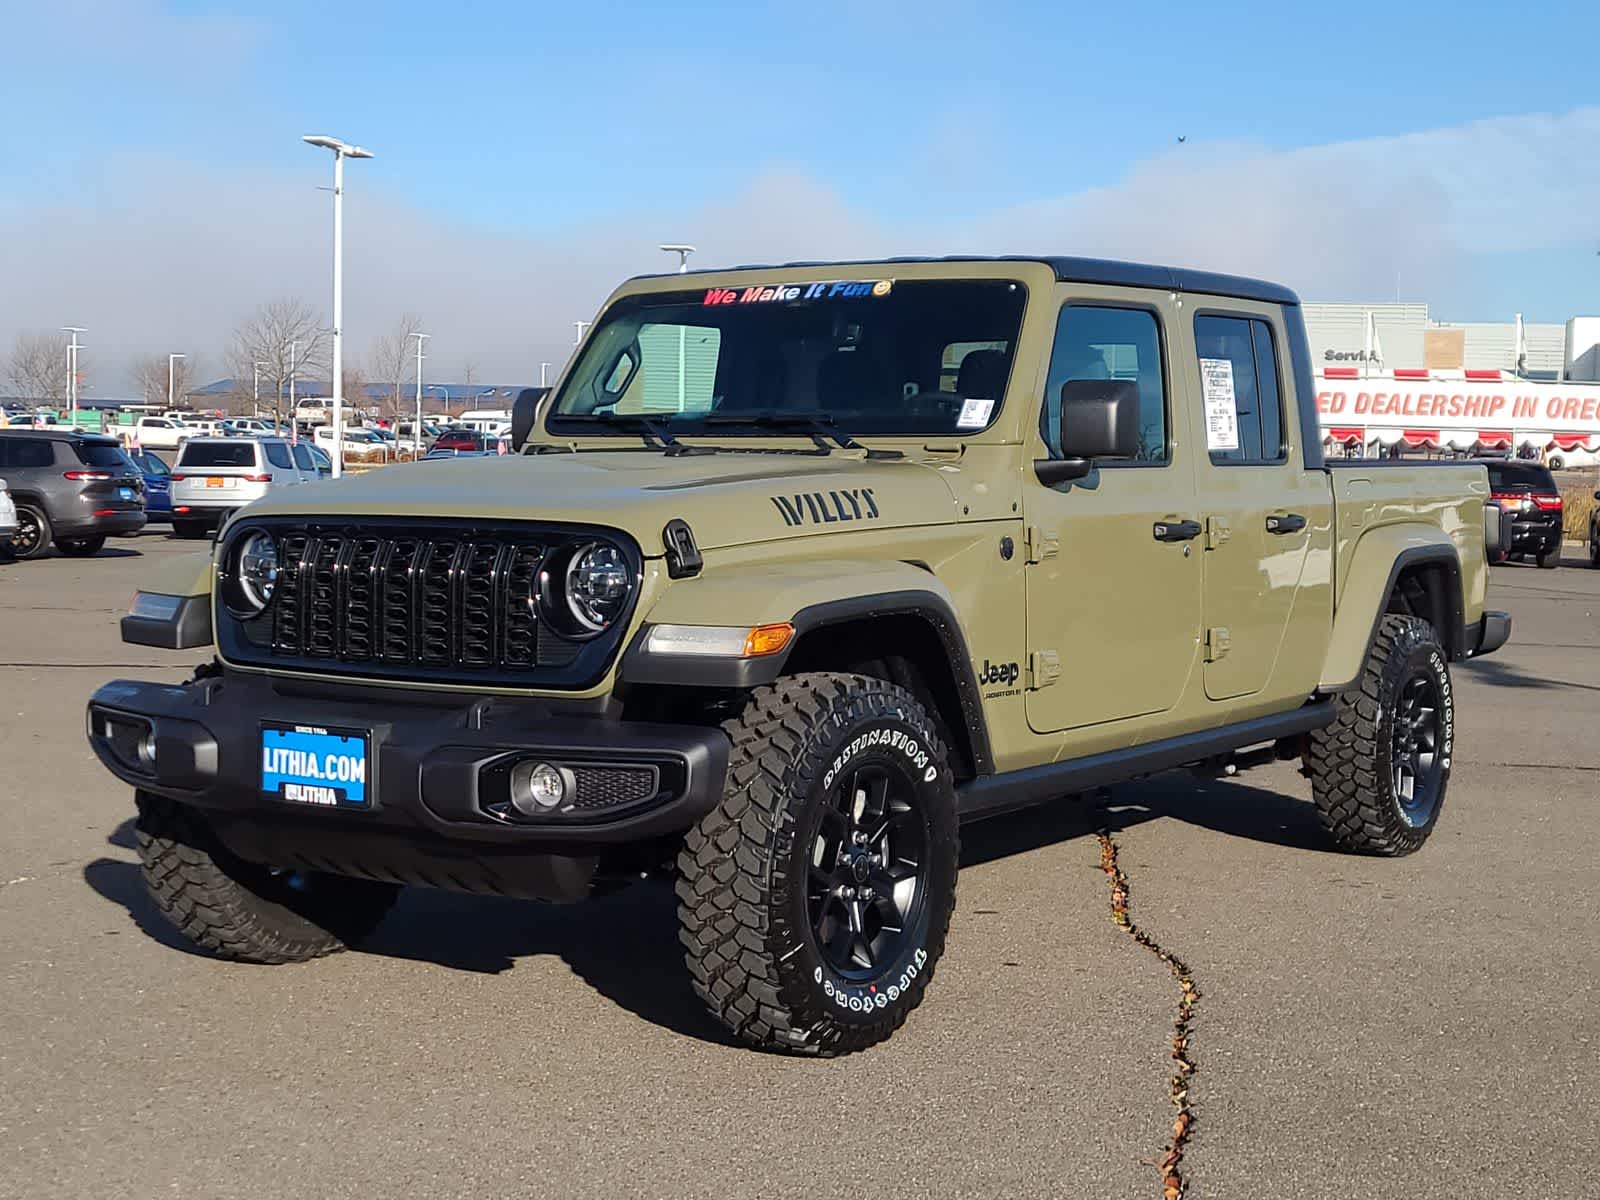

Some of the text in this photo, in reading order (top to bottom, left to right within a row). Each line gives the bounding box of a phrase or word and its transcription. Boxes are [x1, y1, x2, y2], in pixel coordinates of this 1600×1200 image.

[703, 281, 873, 305] We Make It Fun
[1324, 349, 1378, 362] Servi
[1354, 392, 1506, 417] DEALERSHIP
[1511, 395, 1539, 418] IN
[1546, 396, 1600, 421] ORE
[770, 488, 879, 526] WILLYS
[979, 659, 1019, 687] Jeep
[263, 747, 366, 784] LITHIA.COM
[823, 729, 929, 790] DESTINATION
[299, 785, 337, 805] LITHIA
[823, 948, 928, 1013] Firestone
